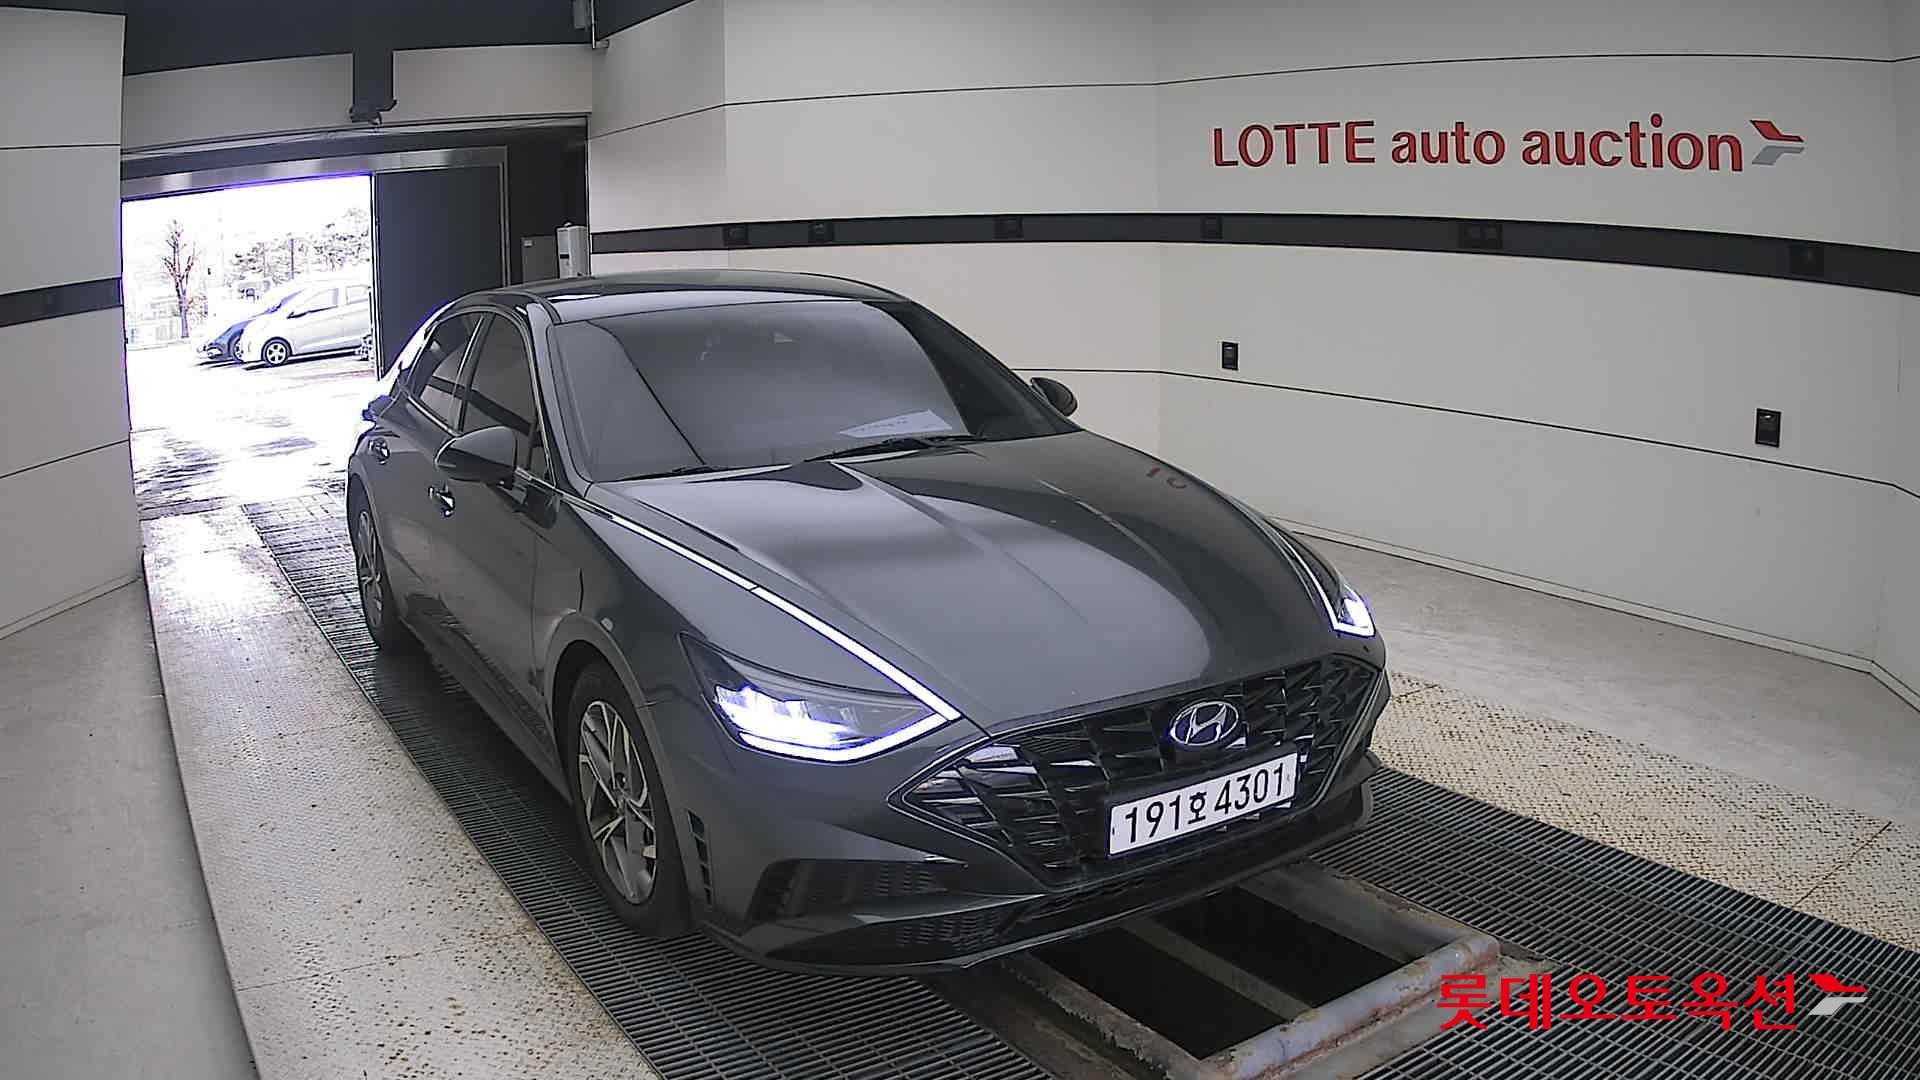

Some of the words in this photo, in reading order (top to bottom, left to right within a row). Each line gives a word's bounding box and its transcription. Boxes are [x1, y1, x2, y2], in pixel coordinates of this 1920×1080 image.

[1213, 120, 1376, 168] LOTTE
[1391, 121, 1506, 165] auto
[1522, 114, 1744, 172] auction
